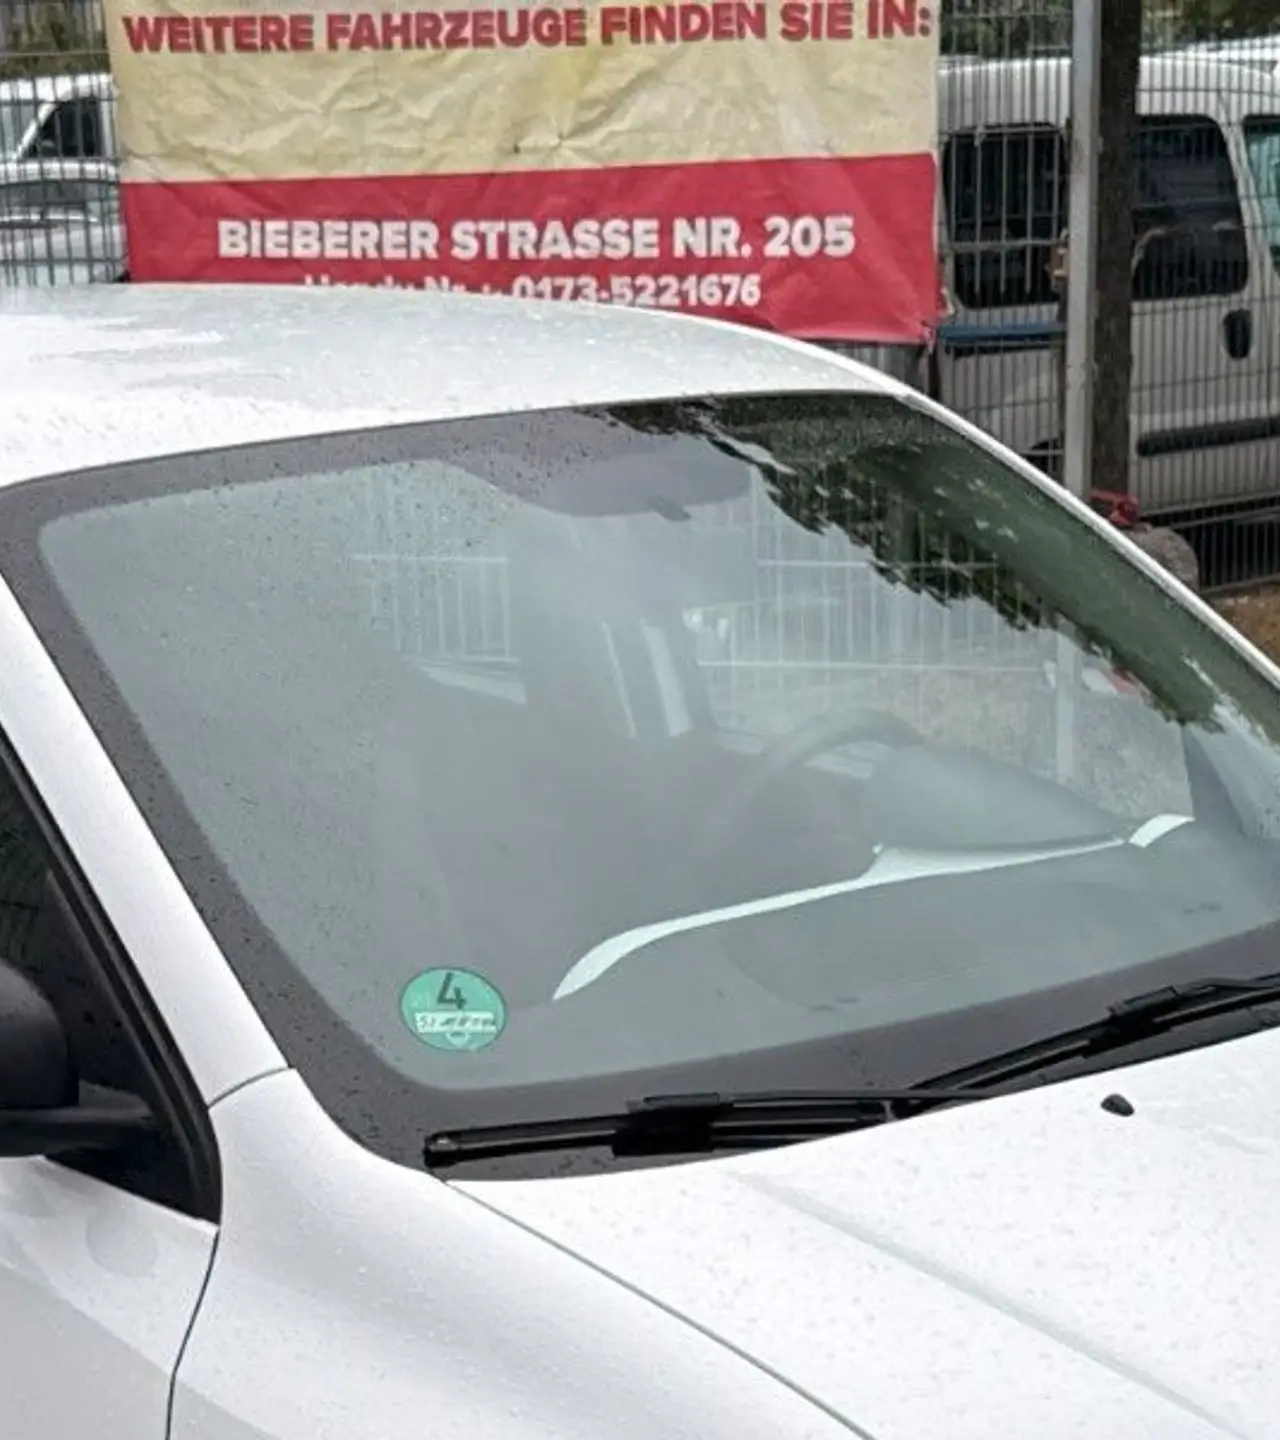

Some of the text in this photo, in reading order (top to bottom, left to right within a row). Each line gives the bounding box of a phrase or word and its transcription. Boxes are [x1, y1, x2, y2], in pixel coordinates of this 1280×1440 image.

[122, 0, 932, 54] WEITERE FAHRZEUGE FINDEN SIE IN:
[218, 215, 856, 260] BIEBERER STRASSE NR. 205
[512, 273, 761, 306] 0173-5221676
[437, 972, 468, 1010] 4
